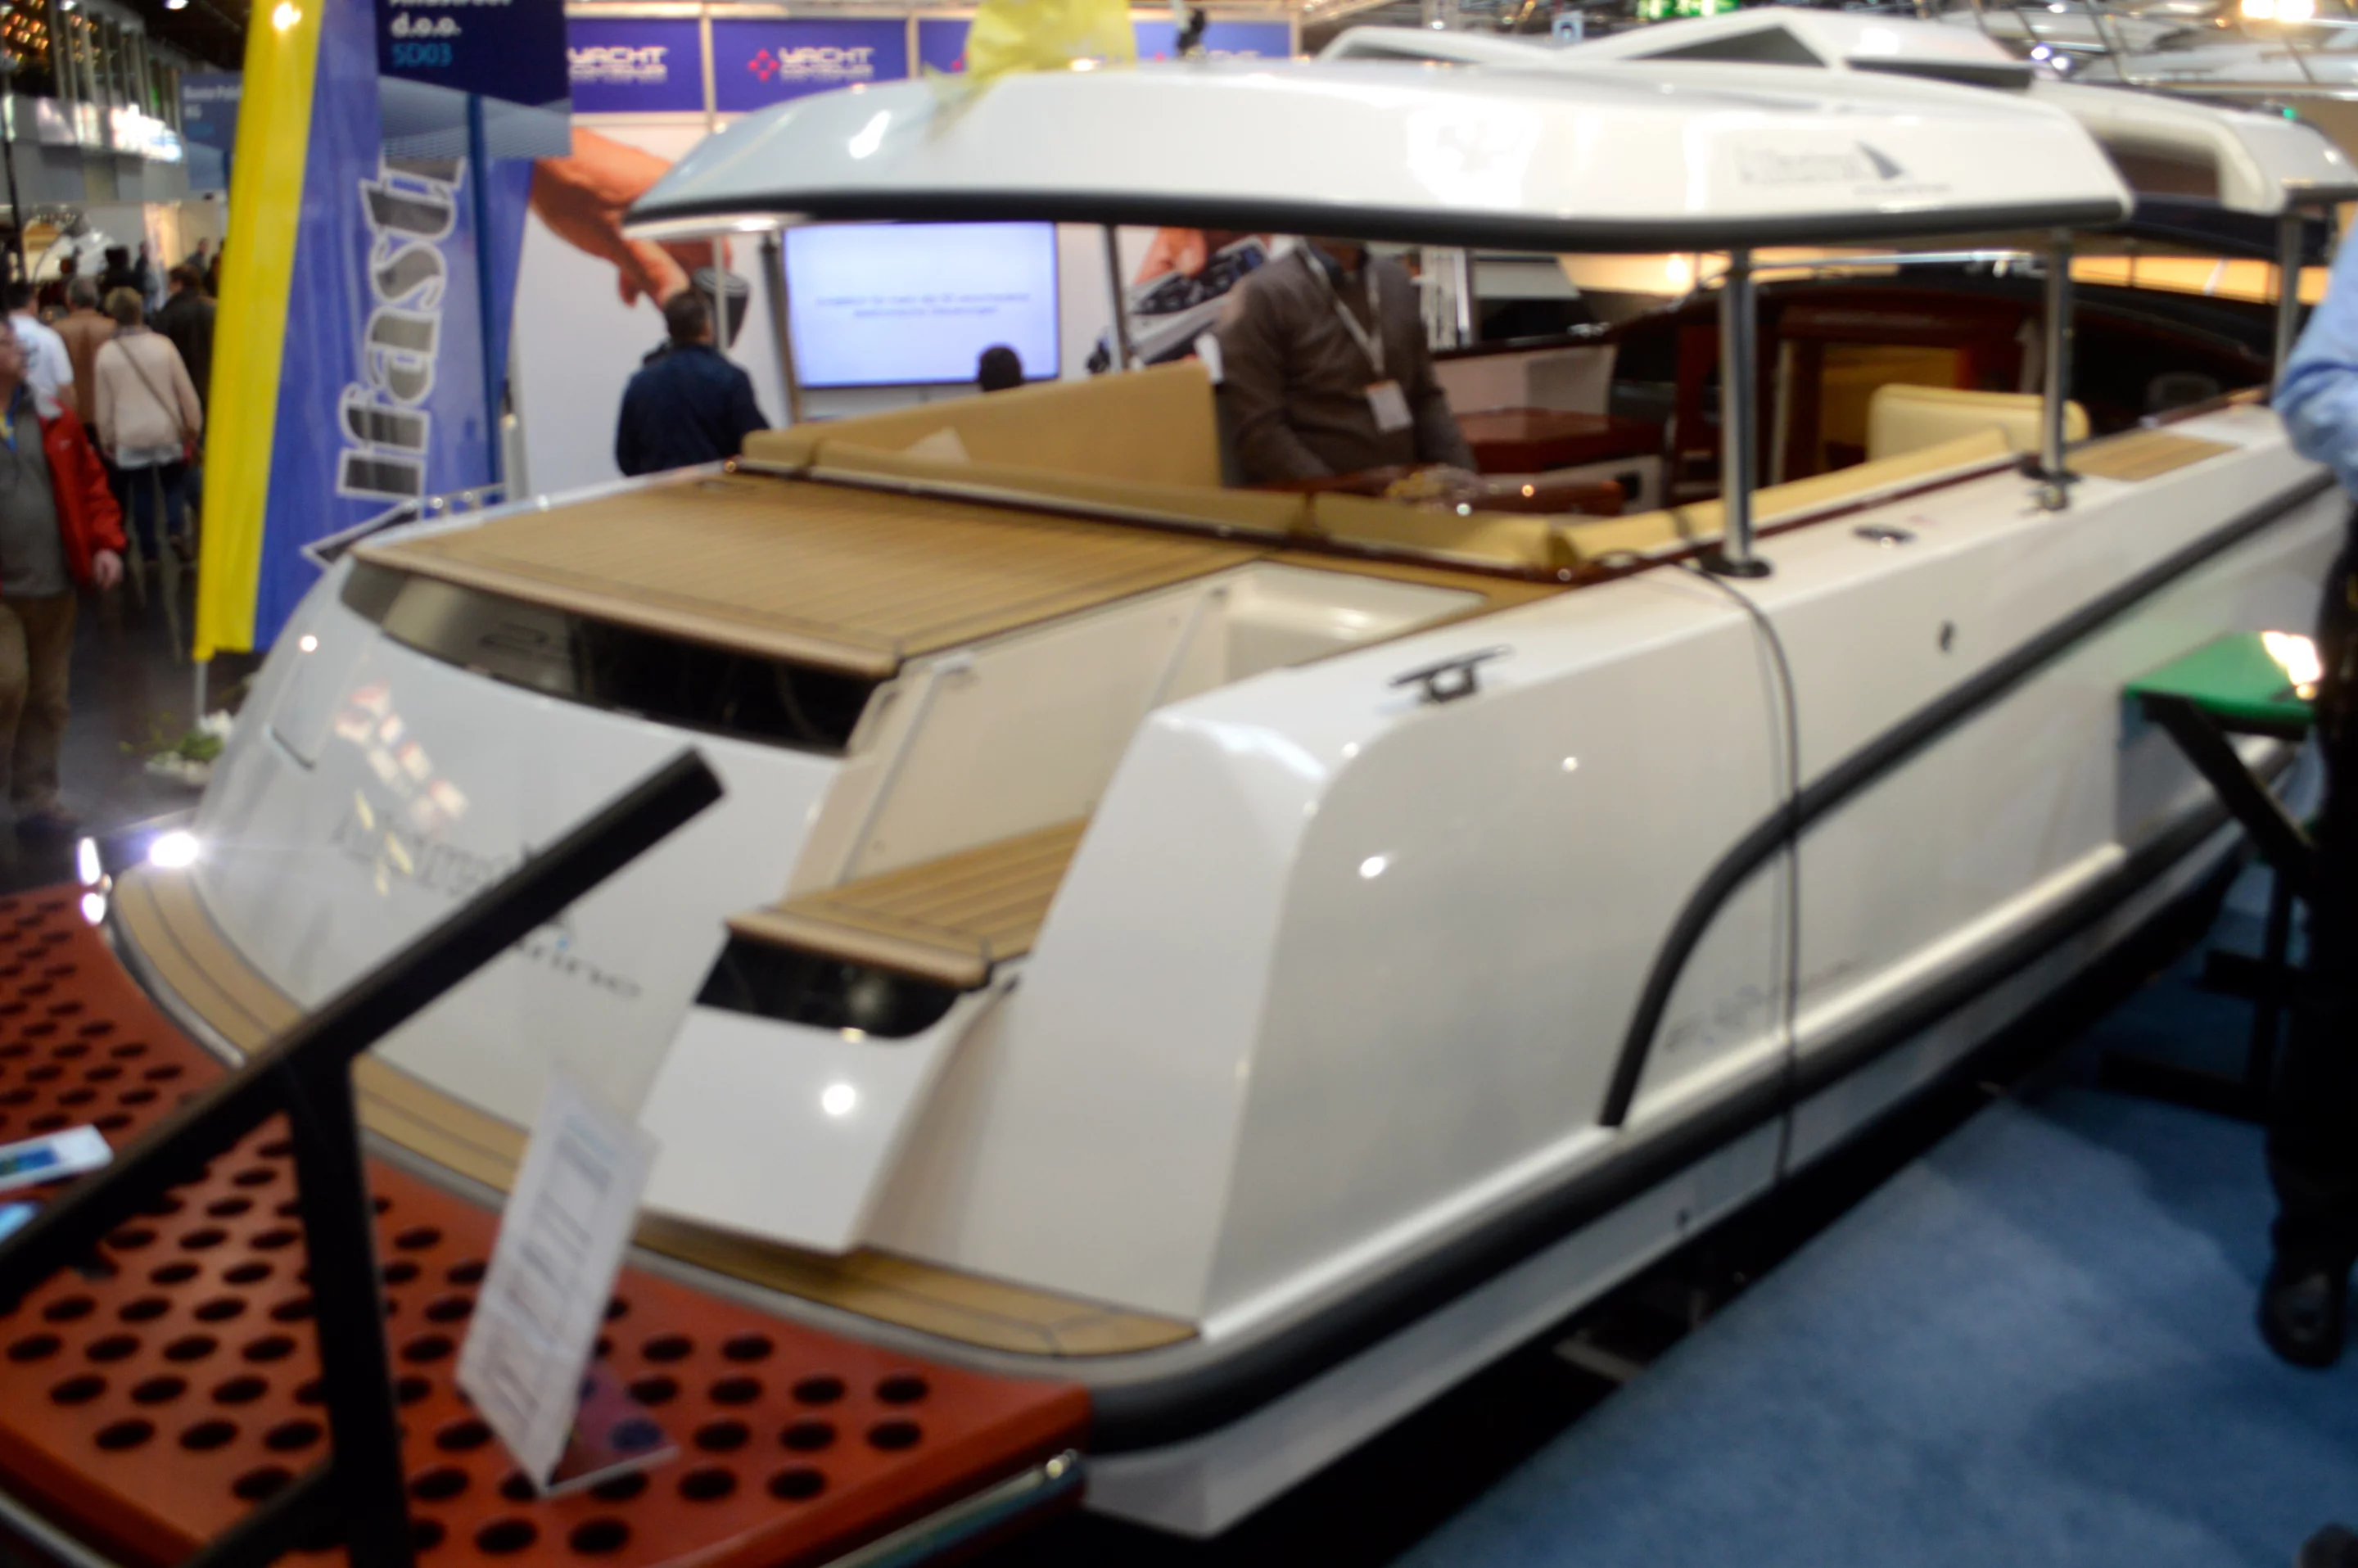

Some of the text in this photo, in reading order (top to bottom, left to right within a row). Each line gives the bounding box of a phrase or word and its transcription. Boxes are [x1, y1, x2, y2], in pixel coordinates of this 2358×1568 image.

[390, 12, 461, 38] d.o.o.
[567, 47, 669, 64] YACHT
[779, 47, 874, 64] YACHT
